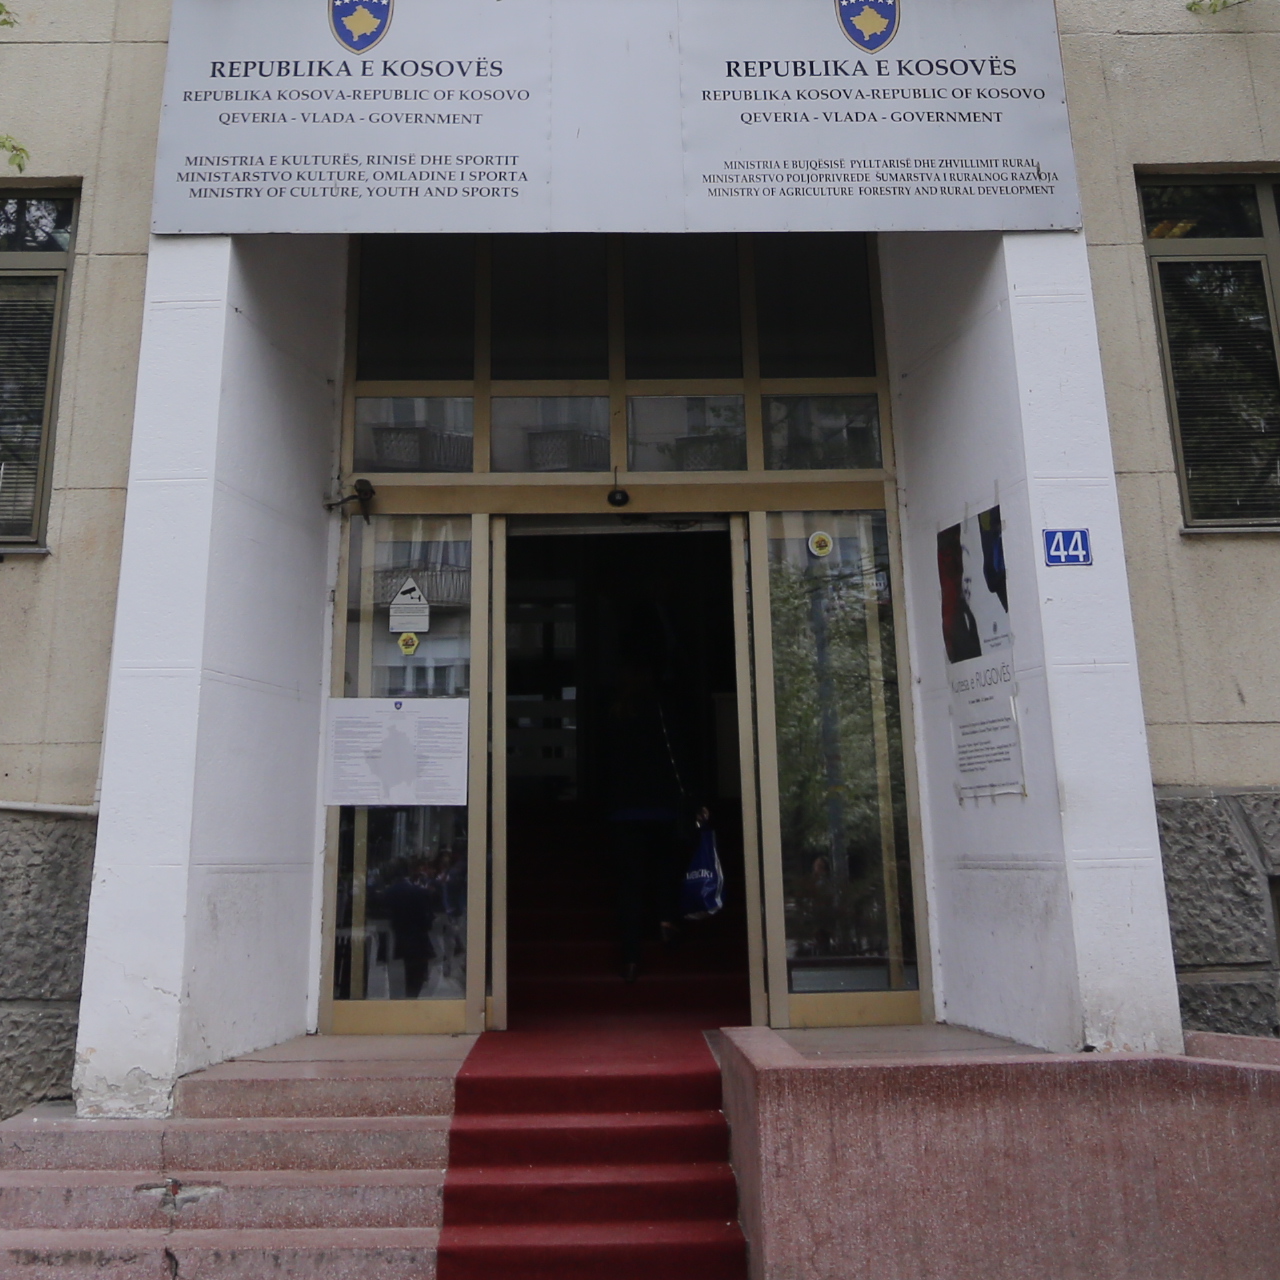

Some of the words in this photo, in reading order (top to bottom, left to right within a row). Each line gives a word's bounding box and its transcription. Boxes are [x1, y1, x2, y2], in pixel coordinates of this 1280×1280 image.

[210, 60, 352, 78] REPUBLIKA
[362, 60, 374, 77] E
[382, 56, 503, 78] KOSOVËS
[725, 59, 869, 78] REPUBLIKA
[876, 59, 890, 77] E
[896, 55, 1017, 77] KOSOVËS
[183, 89, 272, 102] REPUBLIKA
[277, 89, 429, 101] KOSOVA-REPUBLIC
[434, 89, 455, 101] OF
[459, 89, 530, 101] KOSOVO
[702, 88, 792, 101] REPUBLIKA
[796, 87, 948, 101] KOSOVA-REPUBLIC
[952, 87, 973, 100] OF
[976, 87, 1046, 100] KOSOVO
[218, 112, 287, 125] QEVERIA
[301, 112, 355, 123] VLADA
[368, 112, 483, 125] GOVERNMENT
[740, 111, 810, 125] QEVERIA
[823, 111, 878, 123] VLADA
[890, 111, 1003, 123] GOVERNMENT
[184, 155, 265, 166] MINISTRIA
[269, 155, 278, 166] E
[281, 153, 362, 167] KULTURËS,
[366, 153, 417, 166] RINISË
[420, 155, 452, 166] DHE
[456, 155, 520, 166] SPORTIT
[724, 160, 781, 170] MINISTRIA
[783, 160, 789, 169] E
[791, 158, 846, 171] BUJQËSISË
[849, 157, 912, 169] PYLLTARISË
[913, 158, 936, 169] DHE
[938, 158, 1000, 169] ZHVILLIMIT
[1001, 158, 1037, 168] RURAL
[176, 171, 293, 182] MINISTARSTVO
[296, 170, 369, 183] KULTURE,
[372, 170, 458, 182] OMLADINE
[460, 171, 465, 182] I
[469, 171, 528, 182] SPORTA
[702, 174, 784, 183] MINISTARSTVO
[786, 173, 871, 184] POLJOPRIVREDE
[875, 171, 941, 182] ŠUMARSTVA
[949, 172, 1009, 182] RURALNOG
[1011, 171, 1059, 183] RAZVOJA
[188, 186, 263, 198] MINISTRY
[266, 187, 288, 198] OF
[290, 186, 362, 199] CULTURE,
[366, 186, 419, 197] YOUTH
[424, 186, 458, 197] AND
[462, 186, 519, 198] SPORTS
[707, 188, 760, 197] MINISTRY
[762, 187, 776, 197] OF
[778, 187, 854, 197] AGRICULTURE
[858, 186, 912, 196] FORESTRY
[914, 186, 938, 196] AND
[940, 186, 976, 196] RURAL
[977, 185, 1055, 196] DEVELOPMENT
[1050, 531, 1086, 562] 44
